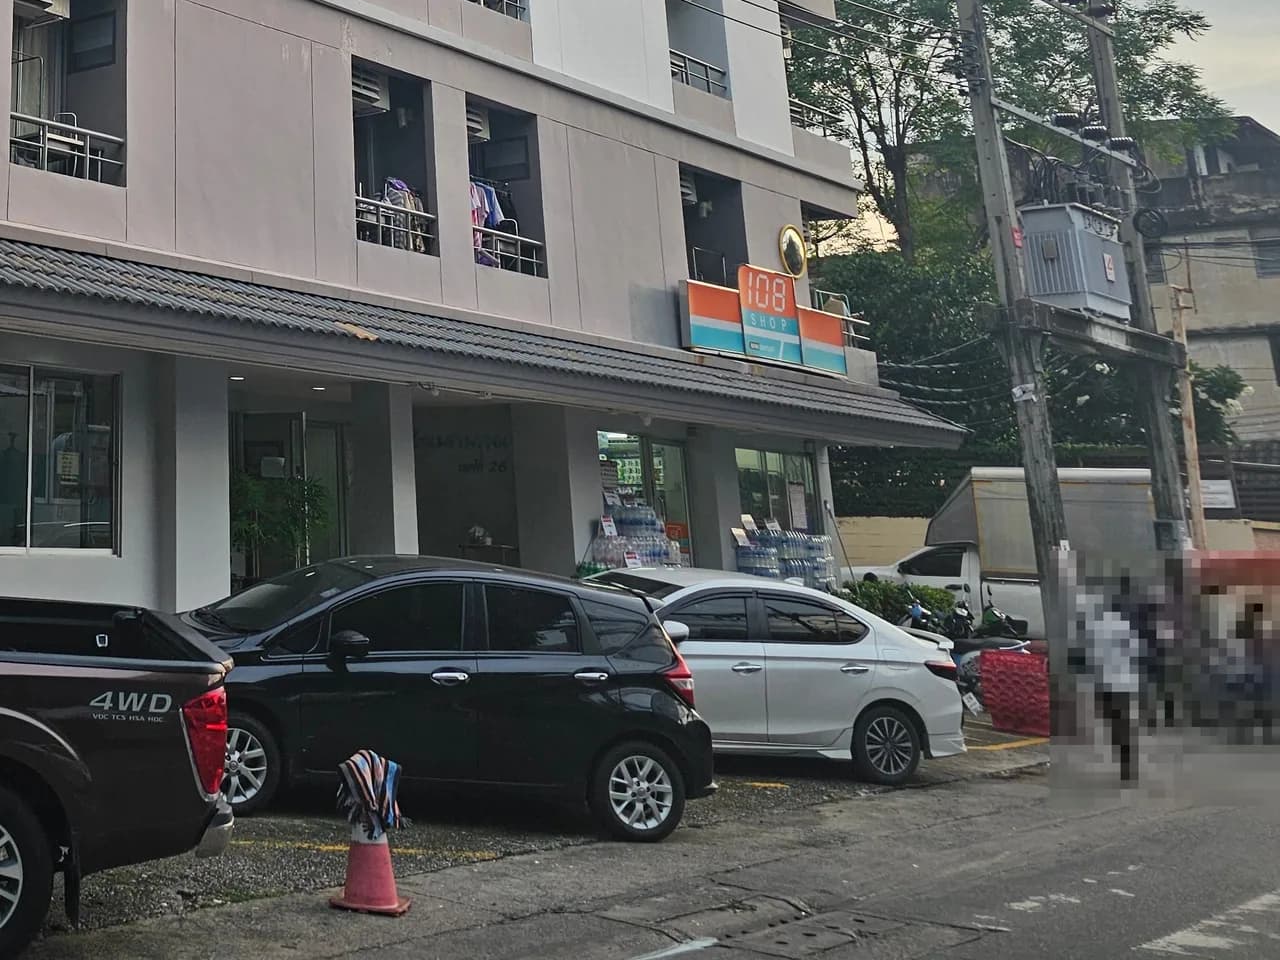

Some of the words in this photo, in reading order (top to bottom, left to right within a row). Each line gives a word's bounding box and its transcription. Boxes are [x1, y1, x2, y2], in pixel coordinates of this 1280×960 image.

[748, 272, 786, 312] 108
[750, 313, 787, 330] SHOP
[89, 691, 172, 713] 4WD
